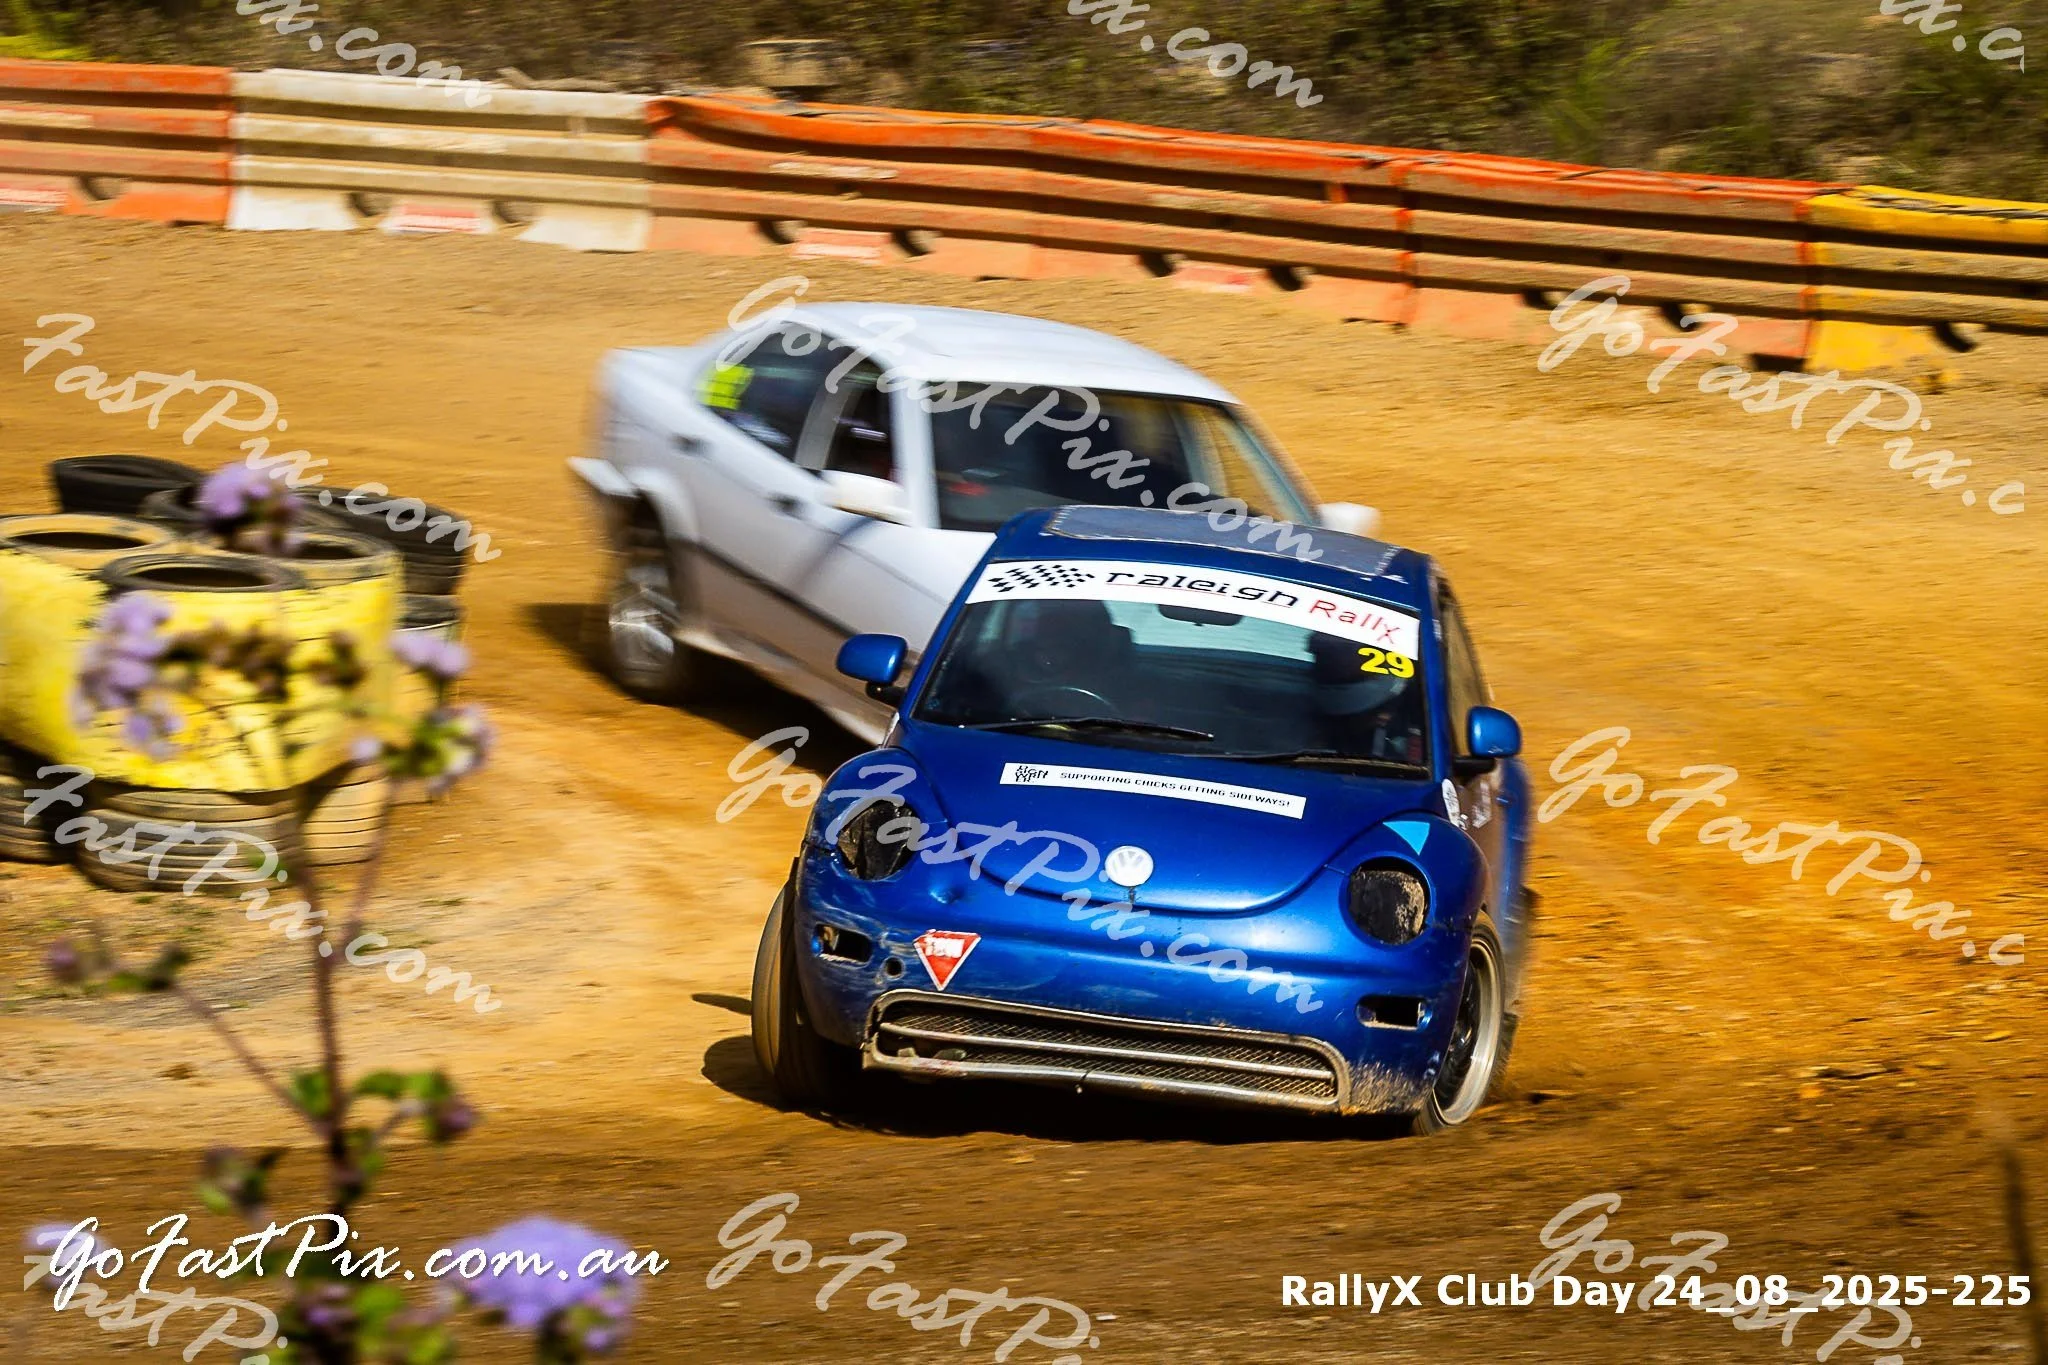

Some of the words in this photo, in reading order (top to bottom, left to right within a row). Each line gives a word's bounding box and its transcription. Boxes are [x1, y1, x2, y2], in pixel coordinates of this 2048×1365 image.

[1358, 647, 1415, 678] 29
[1060, 772, 1131, 785] SUPPORTING
[1134, 779, 1176, 790] CHICKS
[1179, 784, 1226, 797] GETTING
[1229, 791, 1290, 807] SIDEWAYS!
